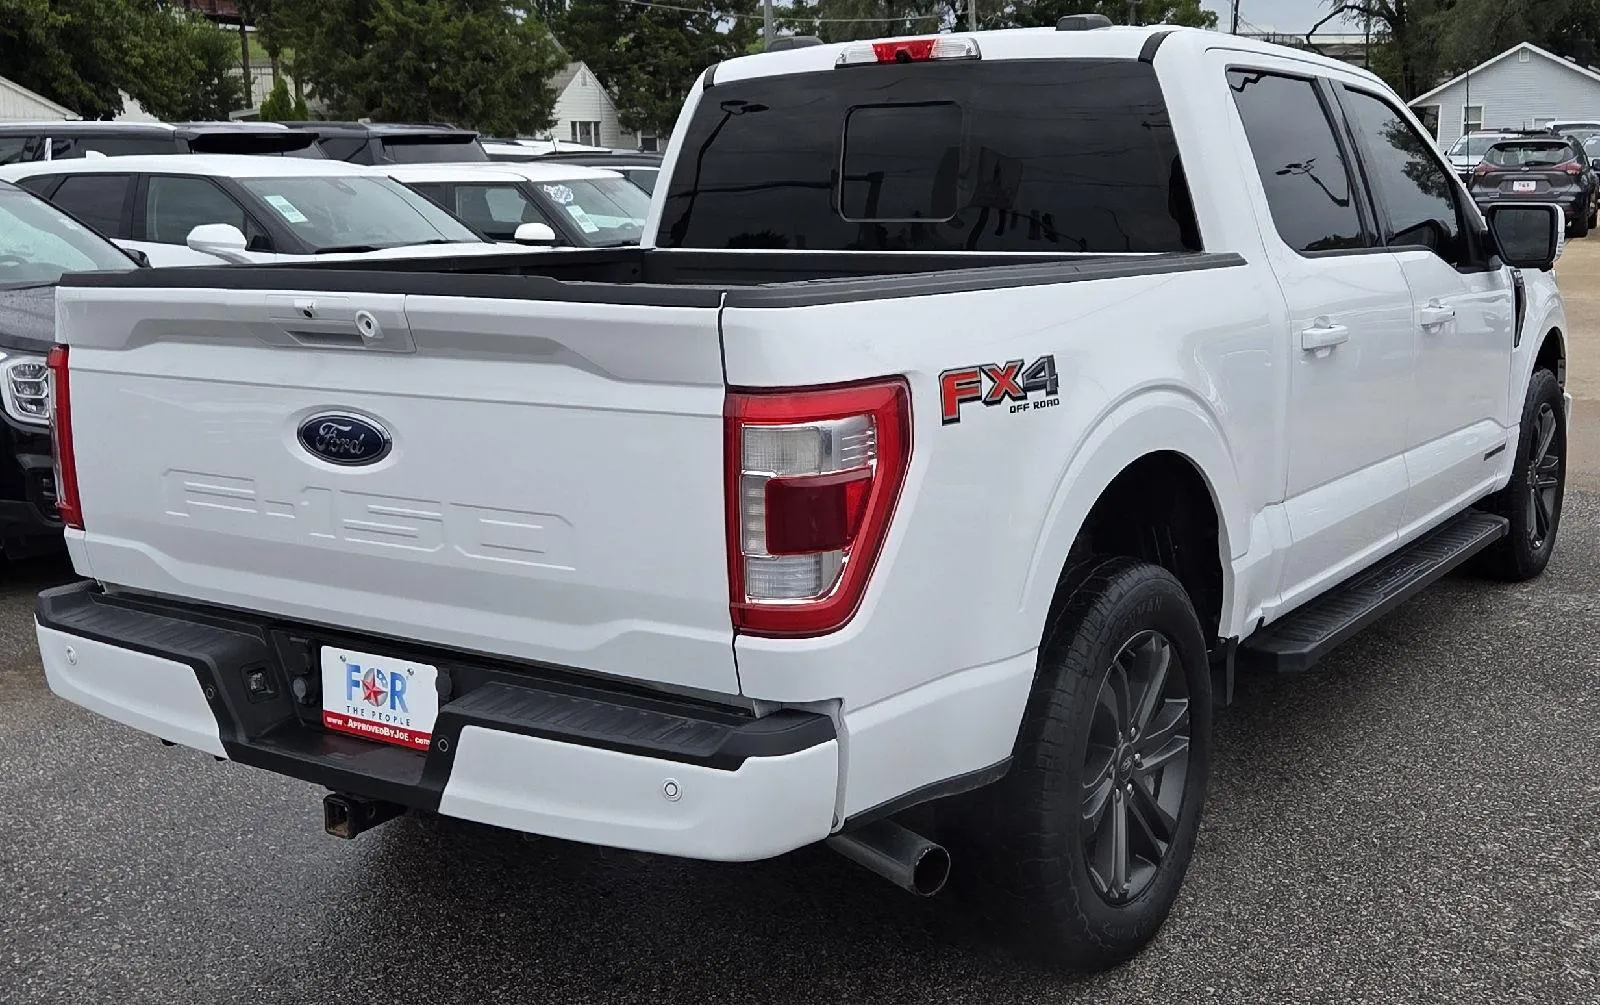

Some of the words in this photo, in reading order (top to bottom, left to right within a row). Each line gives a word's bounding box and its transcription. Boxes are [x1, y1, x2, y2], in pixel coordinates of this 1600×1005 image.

[938, 354, 1059, 426] FX4
[1009, 402, 1030, 414] OFF
[1033, 398, 1060, 410] ROAD
[315, 422, 366, 455] Ford
[163, 468, 577, 572] F-150
[346, 705, 365, 717] THE
[372, 710, 411, 727] PEOPLE
